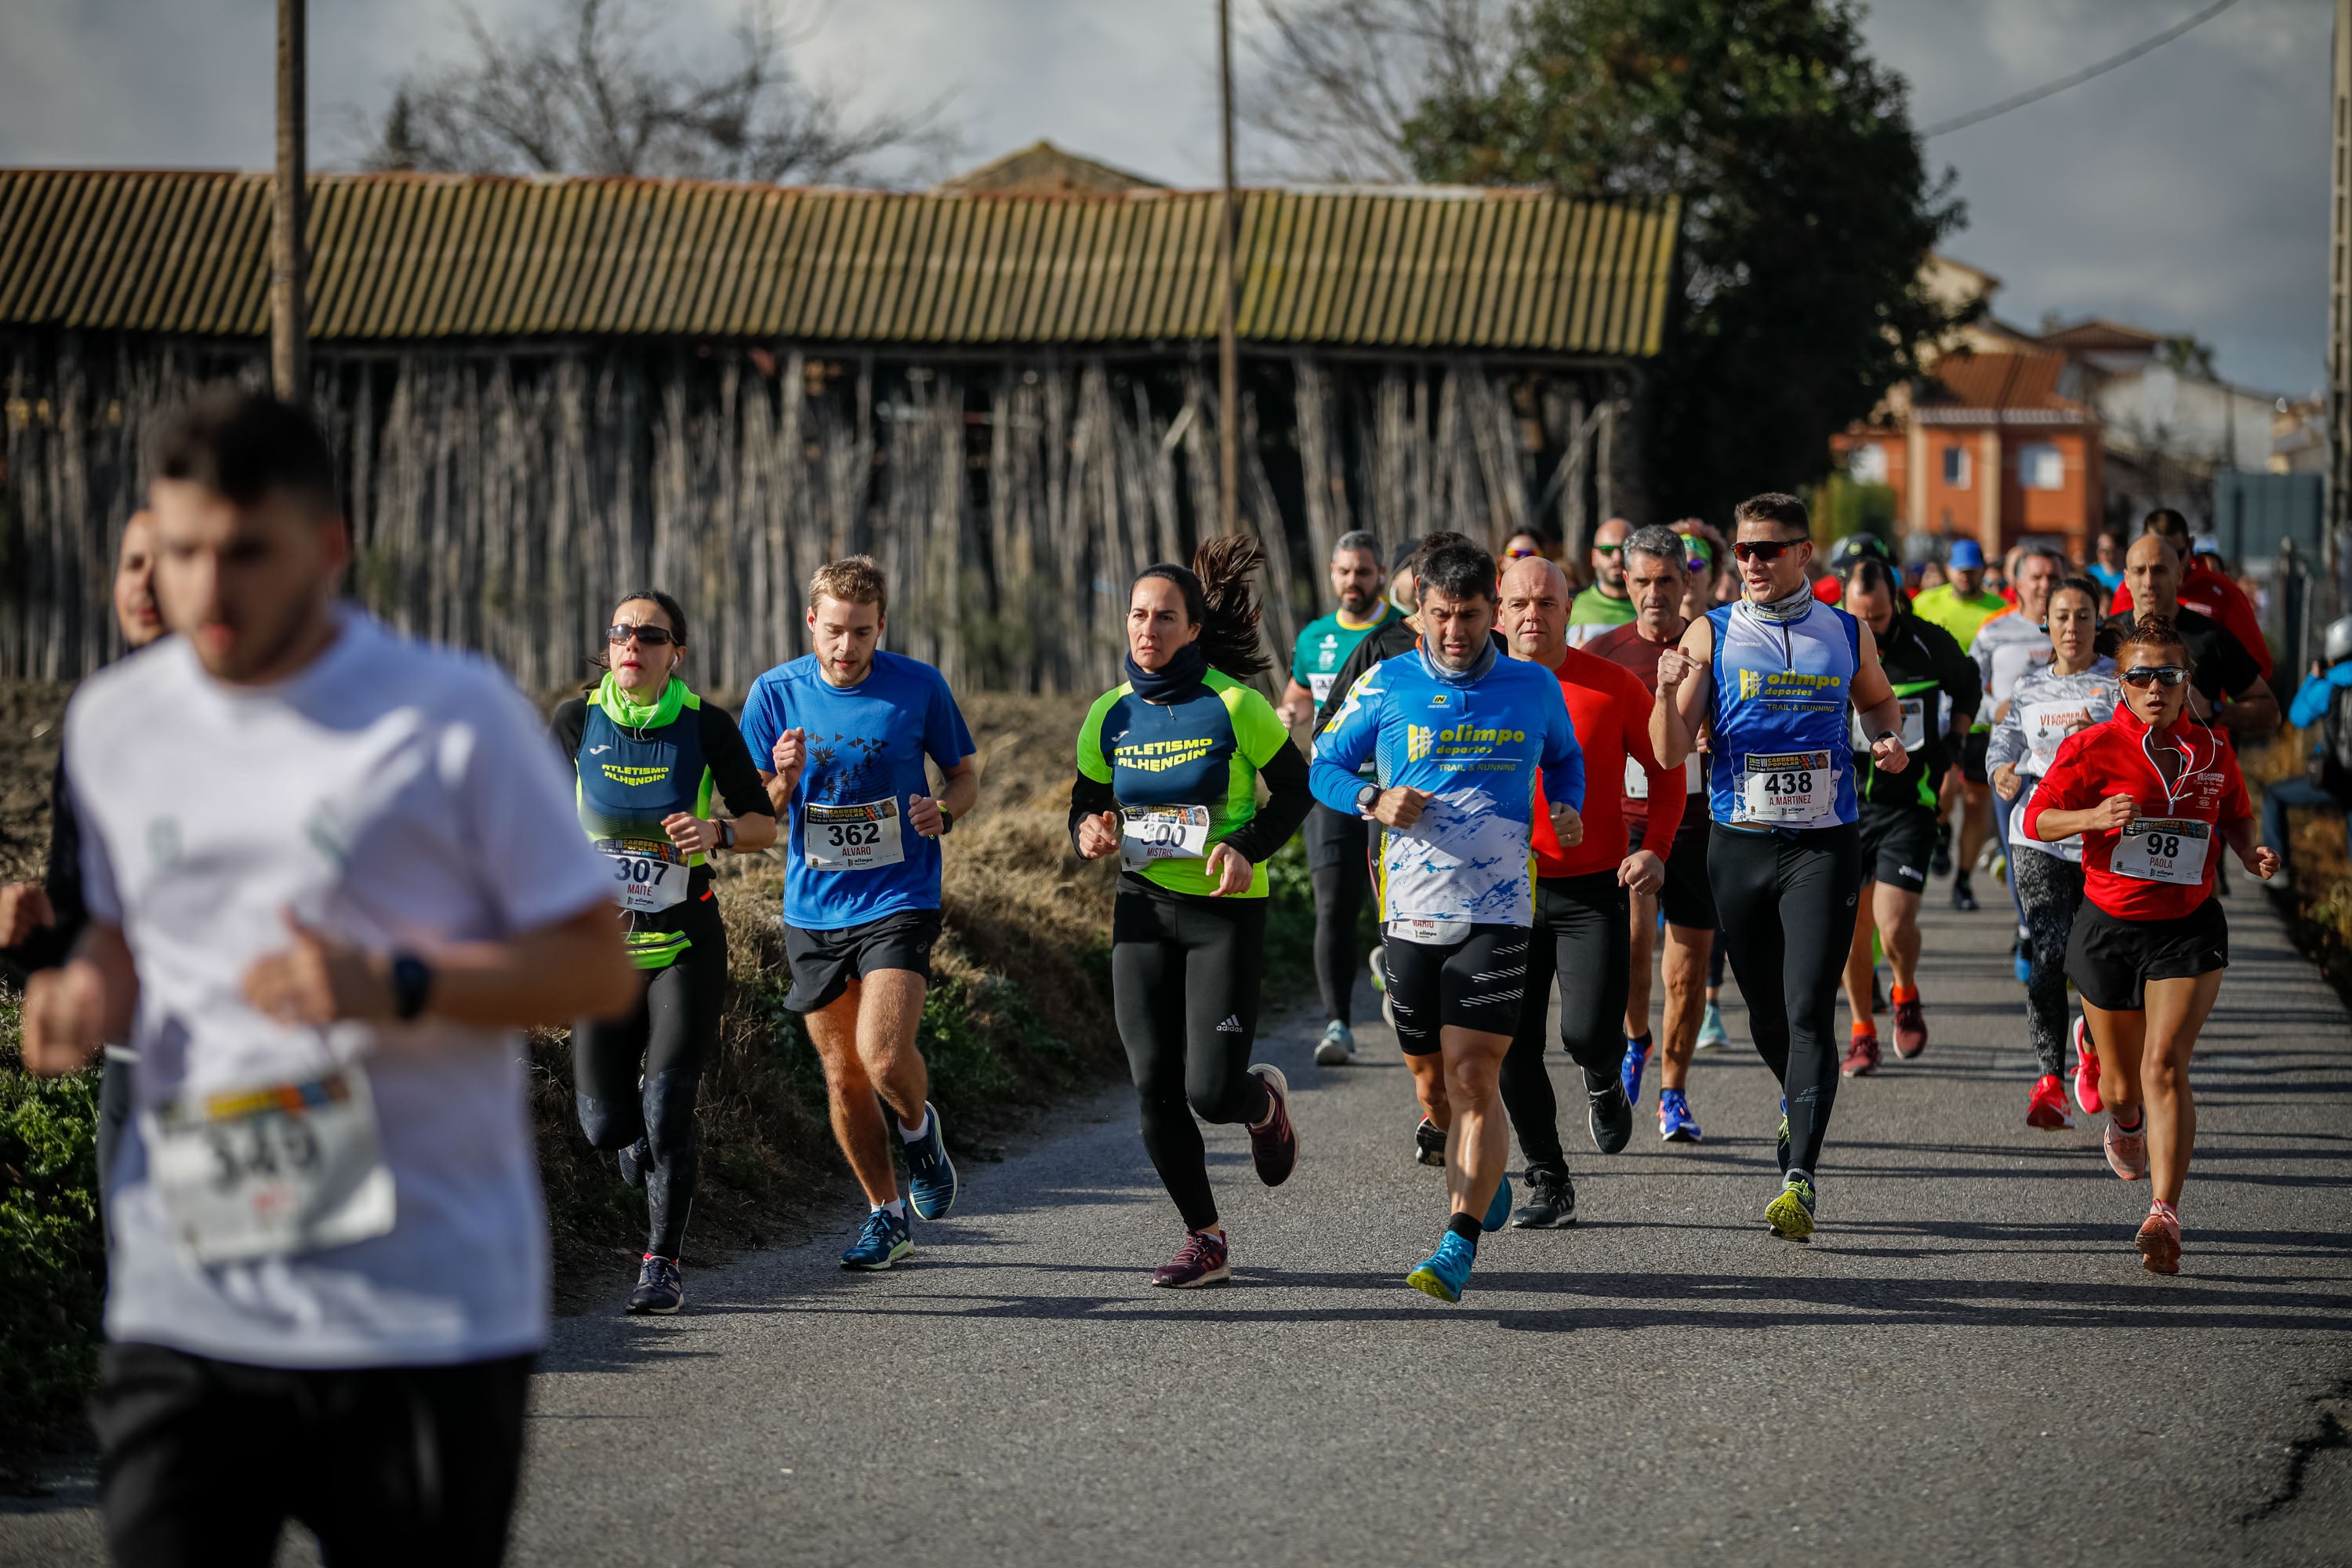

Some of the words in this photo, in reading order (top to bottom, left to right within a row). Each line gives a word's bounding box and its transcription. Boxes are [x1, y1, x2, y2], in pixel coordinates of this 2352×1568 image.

[1767, 670, 1841, 690] olimpo
[1765, 688, 1813, 696] deportes
[2040, 714, 2049, 726] VI
[1439, 724, 1525, 746] olimpo
[1114, 738, 1213, 756] ATLETISMO
[1436, 745, 1493, 756] deportes
[1118, 748, 1207, 772] ALHENDÍN
[601, 764, 670, 775] ATLETISMO
[604, 771, 666, 786] ALHENDÍN
[1764, 772, 1813, 795] 438
[1769, 795, 1811, 806] A.MARTINEZ
[827, 822, 880, 847] 362
[623, 839, 659, 848] CARRERA
[623, 844, 659, 853] POPULAR
[2147, 833, 2180, 858] 98
[842, 846, 871, 856] ÁLVARO
[1146, 847, 1174, 858] MISTRIS
[2149, 857, 2172, 869] PAOLA
[614, 857, 670, 886] 307
[627, 884, 653, 896] MAITE
